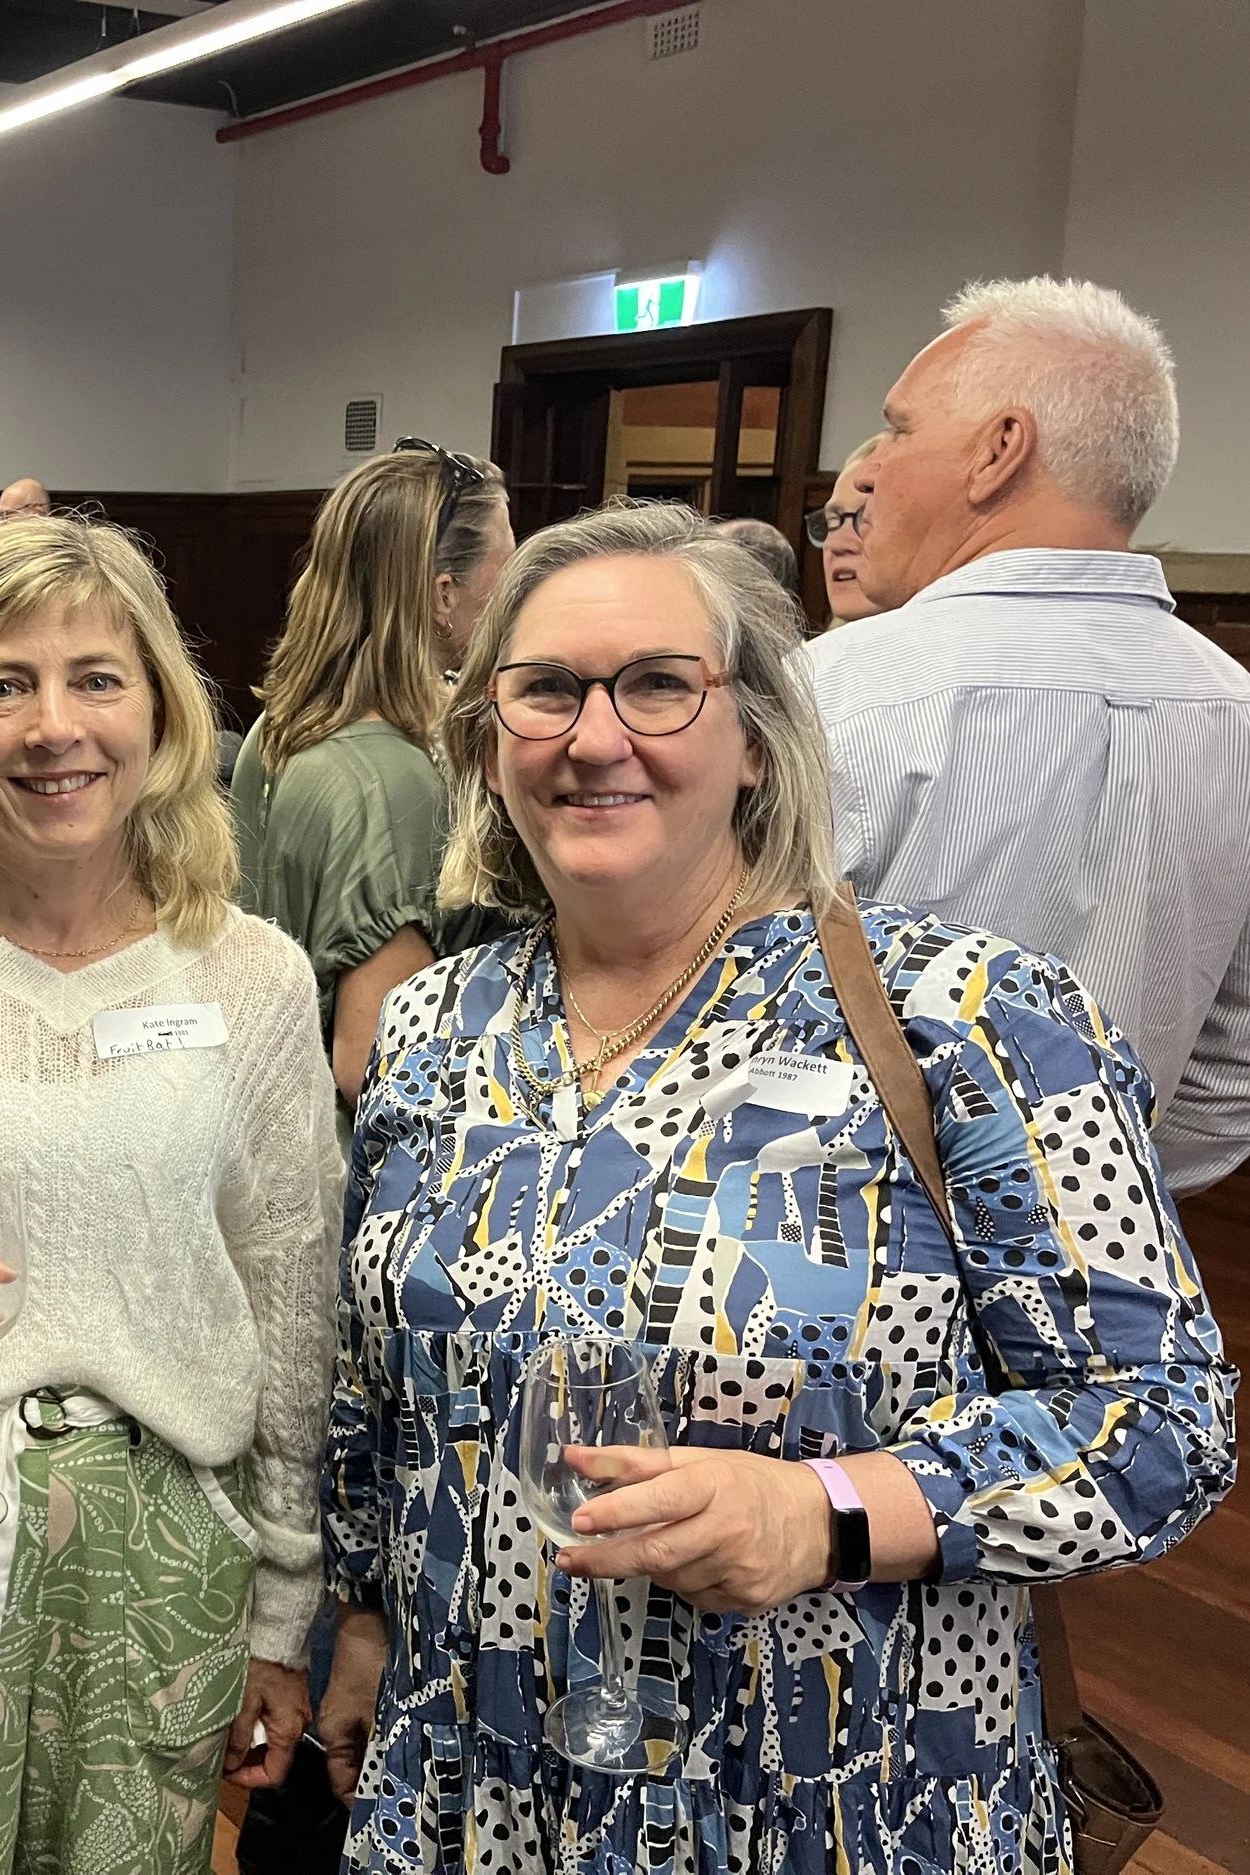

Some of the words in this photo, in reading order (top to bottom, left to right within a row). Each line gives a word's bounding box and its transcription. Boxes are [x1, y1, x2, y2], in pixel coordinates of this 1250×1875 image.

[142, 1019, 164, 1030] Kate
[166, 1018, 198, 1028] Ingram
[109, 1042, 144, 1055] Fruit
[146, 1038, 174, 1052] Bat
[778, 1056, 828, 1074] Wackett
[748, 1067, 776, 1078] Abbott
[777, 1071, 798, 1081] 1987
